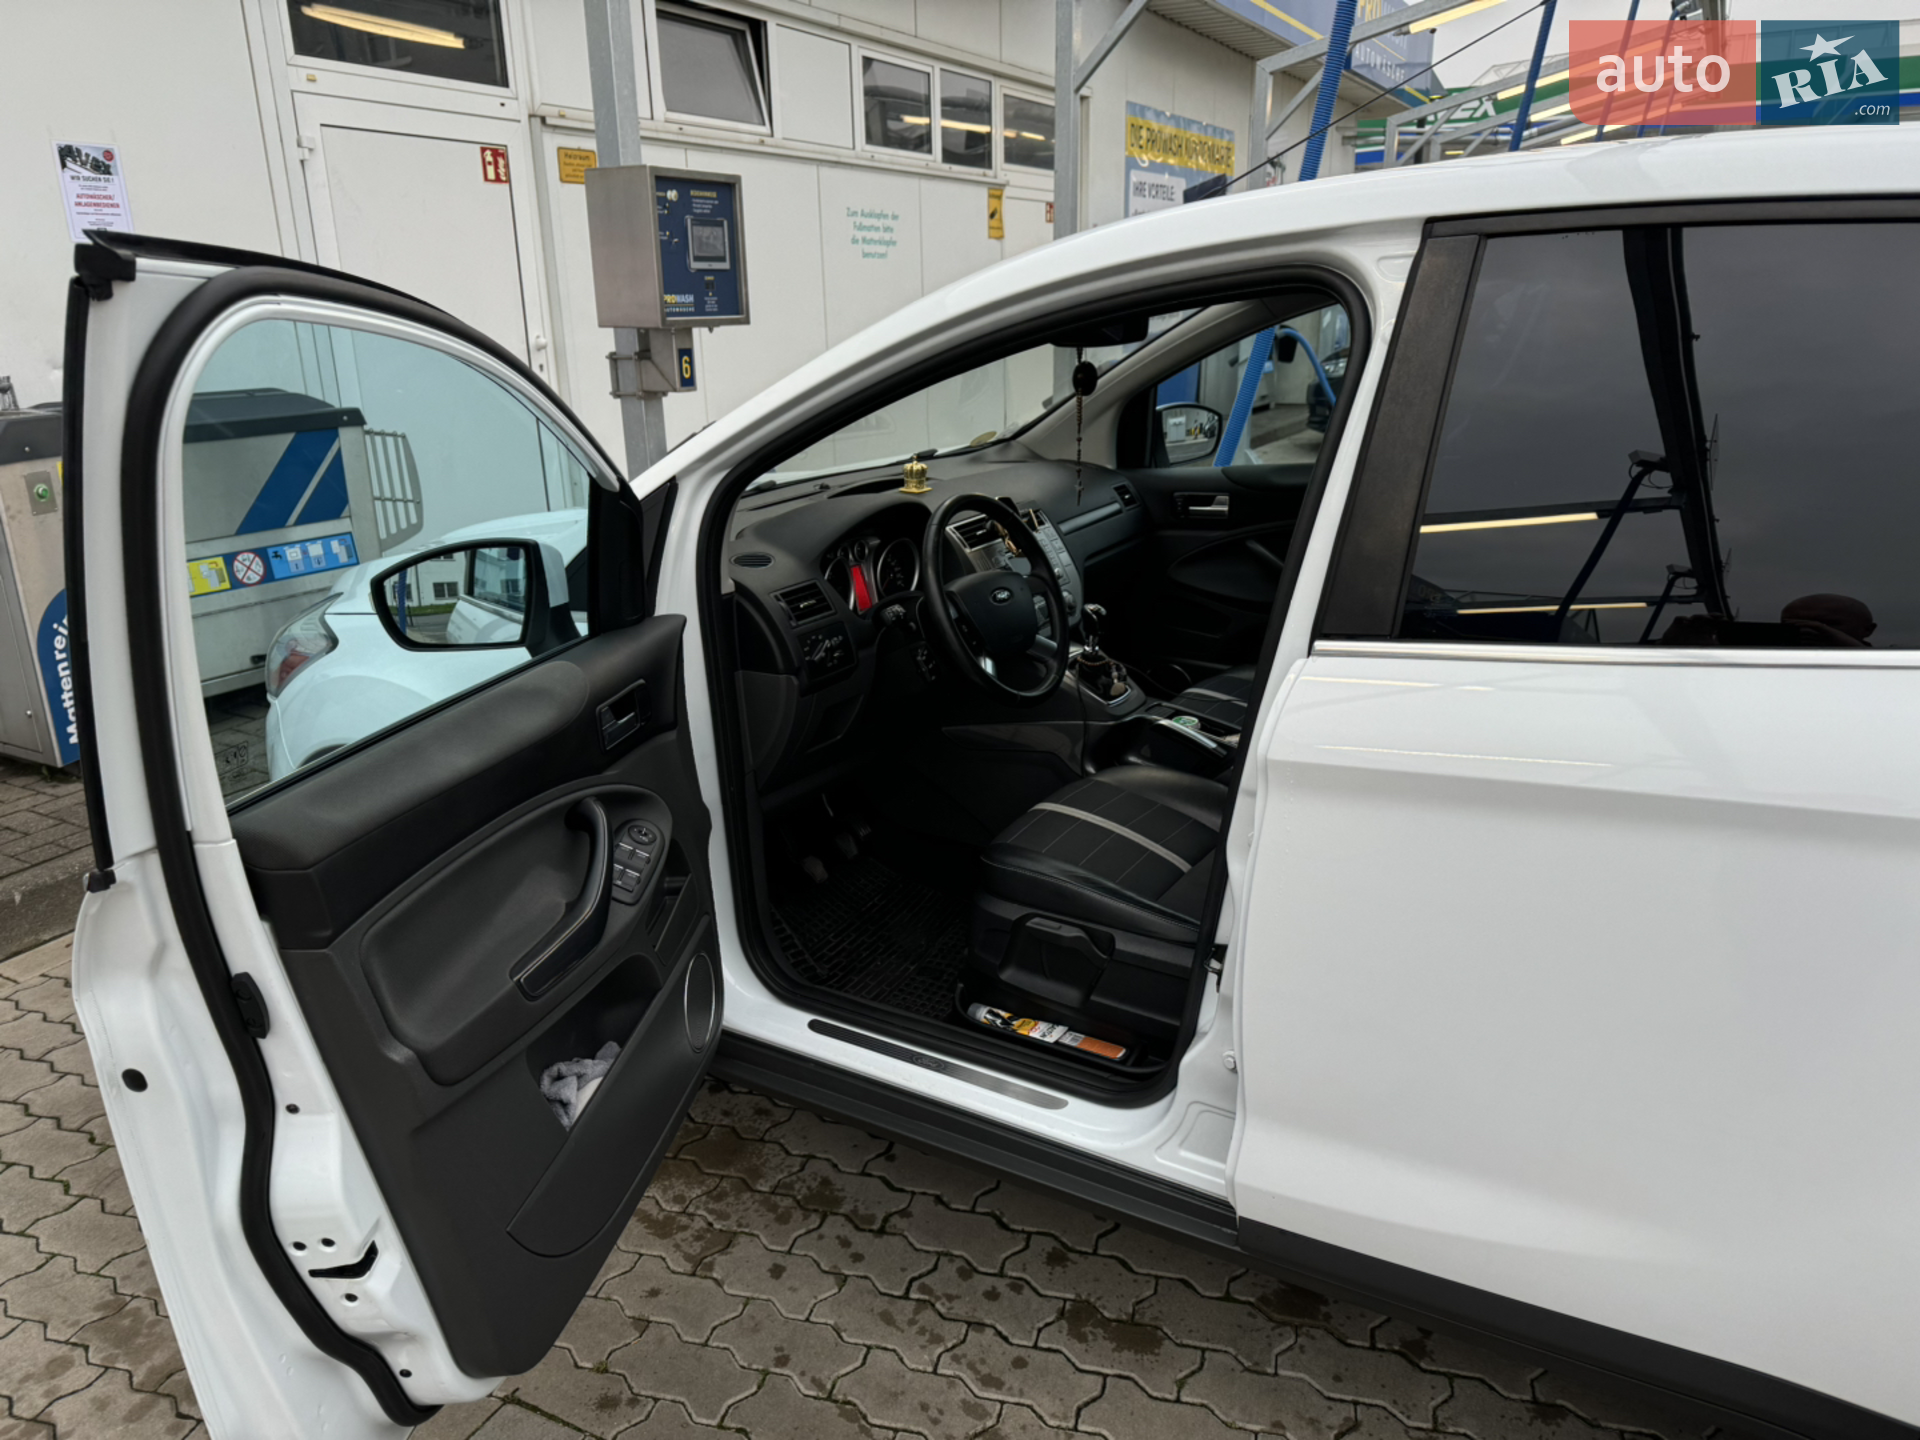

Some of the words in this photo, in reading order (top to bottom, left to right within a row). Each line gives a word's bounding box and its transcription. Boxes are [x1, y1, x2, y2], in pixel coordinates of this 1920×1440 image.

[82, 175, 102, 183] SUCHEN
[846, 206, 859, 218] Zum
[860, 208, 889, 222] Ausklopfen
[890, 210, 900, 221] der
[853, 220, 881, 232] Fußmatten
[882, 222, 894, 234] bitte
[851, 234, 860, 245] die
[861, 235, 897, 248] Mattenklopfer
[682, 355, 692, 379] 6
